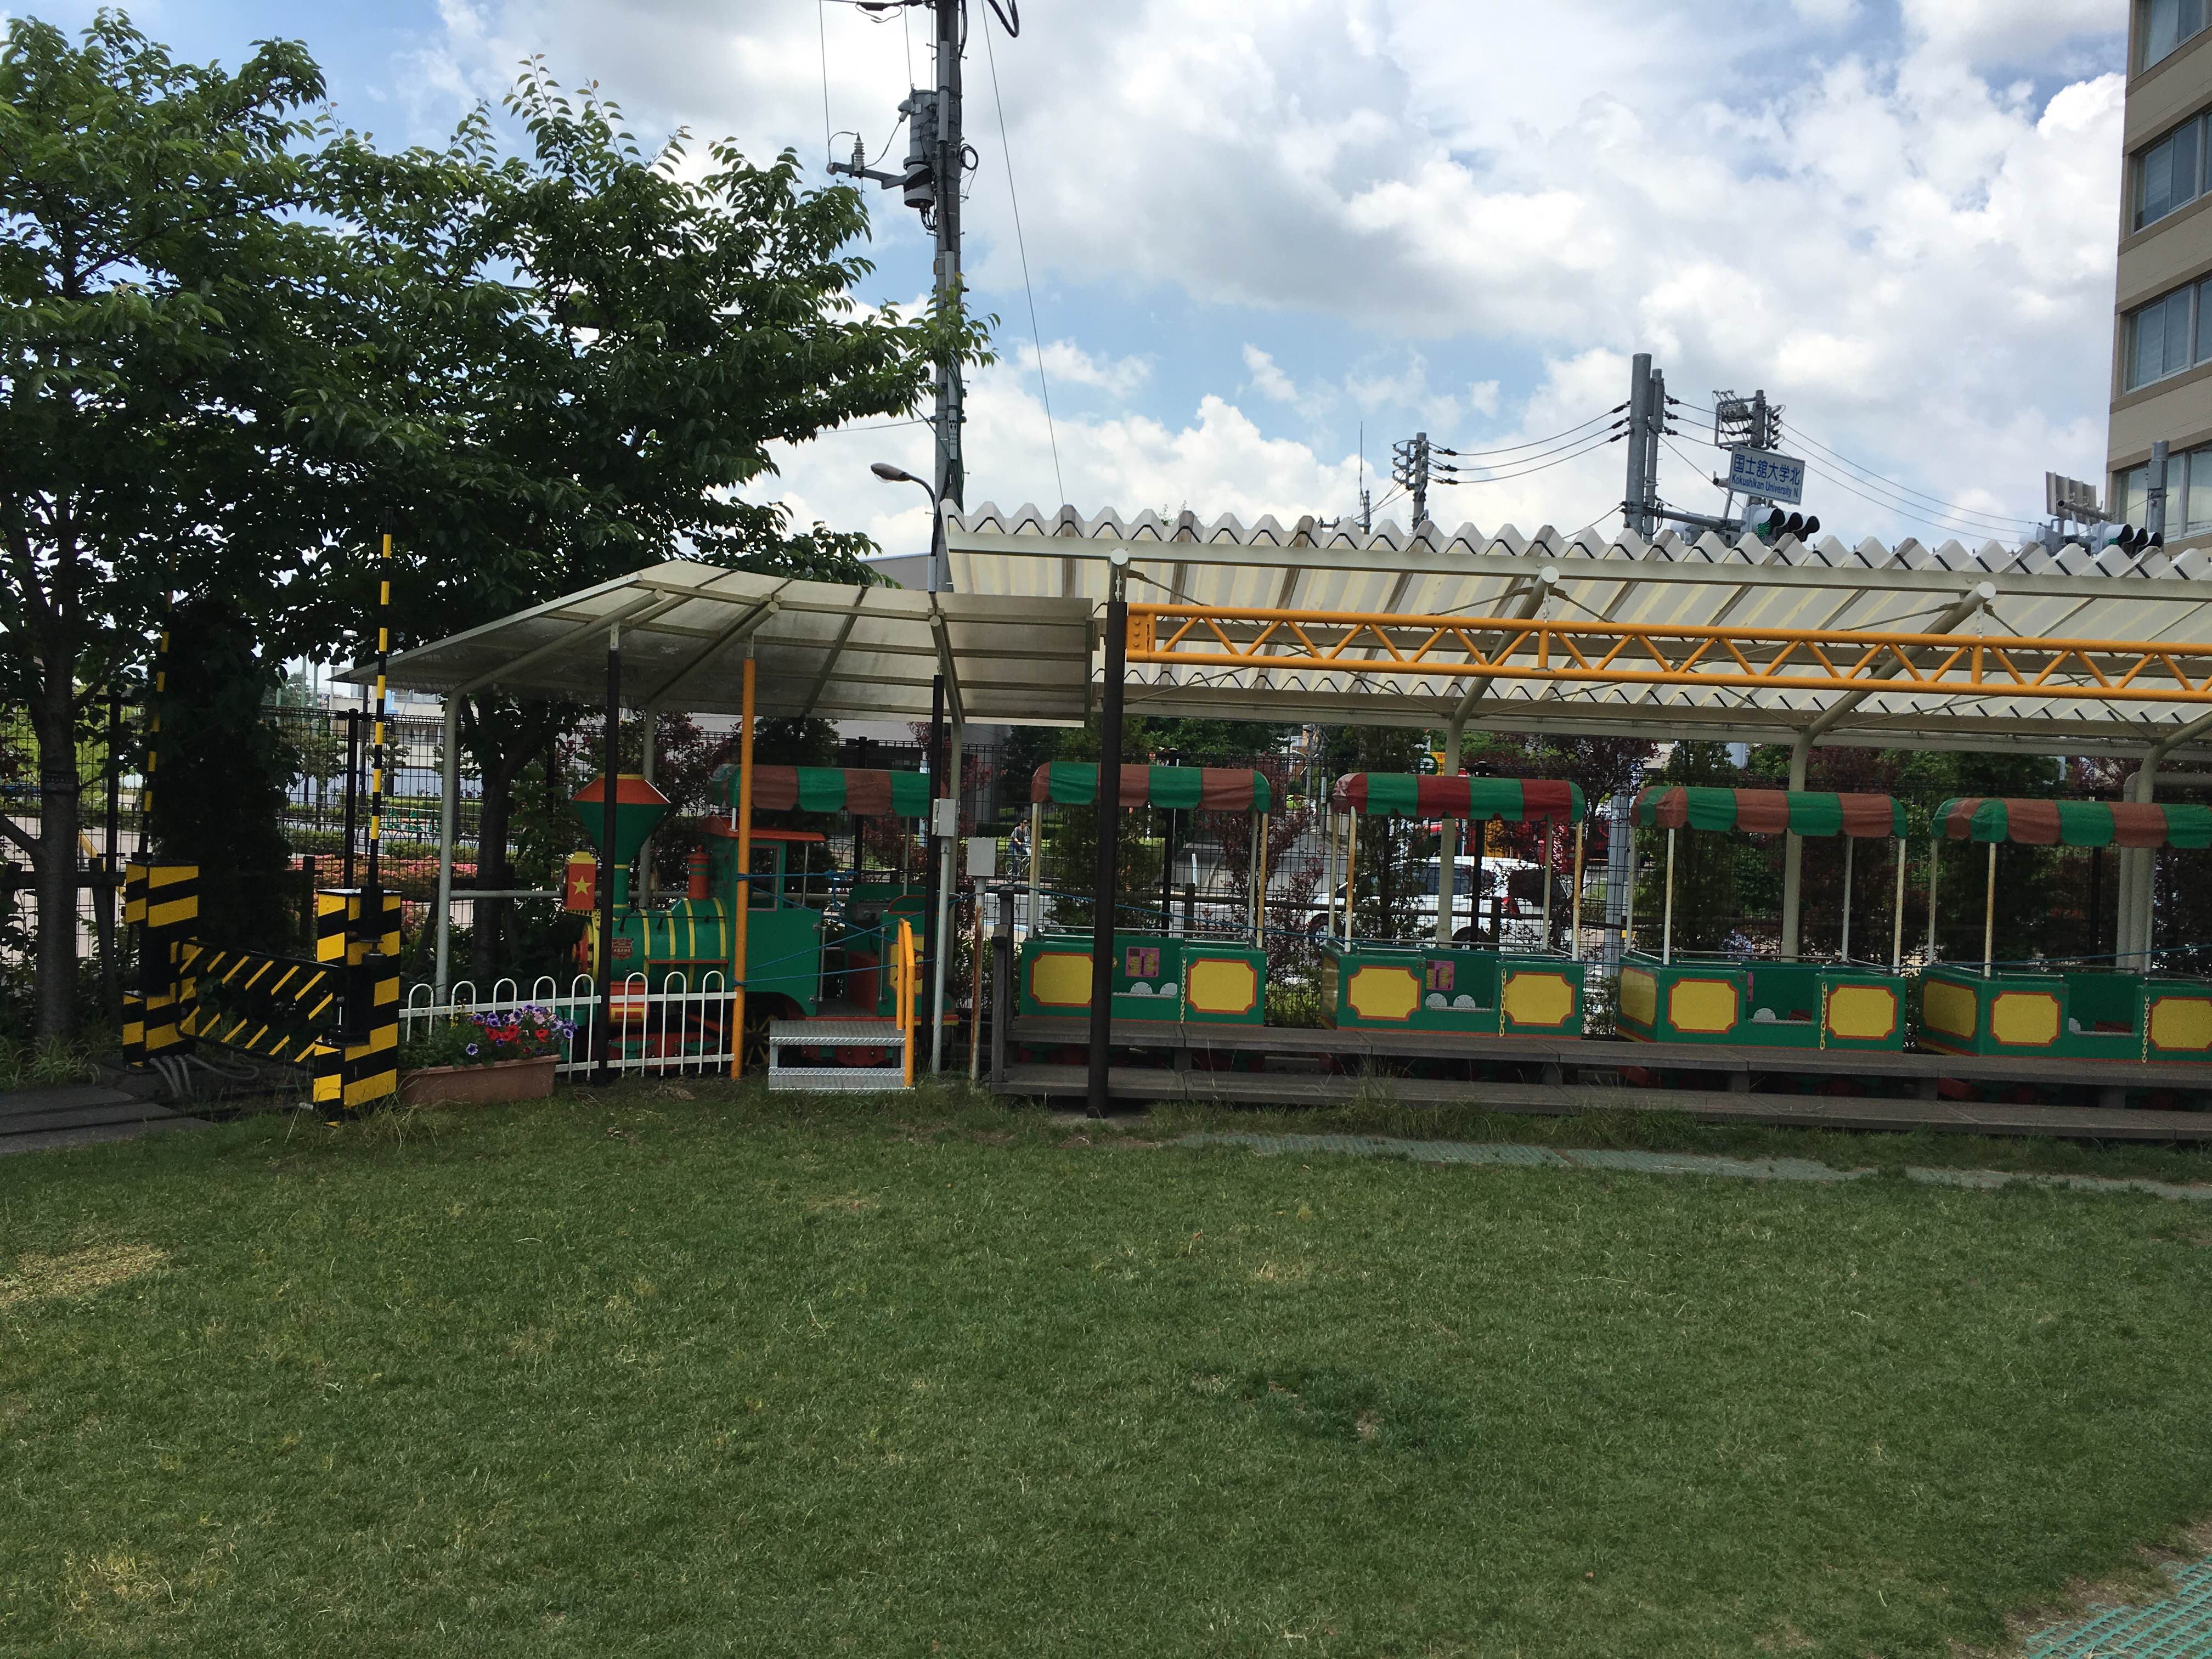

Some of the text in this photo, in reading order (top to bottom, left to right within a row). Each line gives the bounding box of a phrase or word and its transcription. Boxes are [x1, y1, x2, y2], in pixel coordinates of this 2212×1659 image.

[1732, 474, 1798, 497] Kokushikan University N
